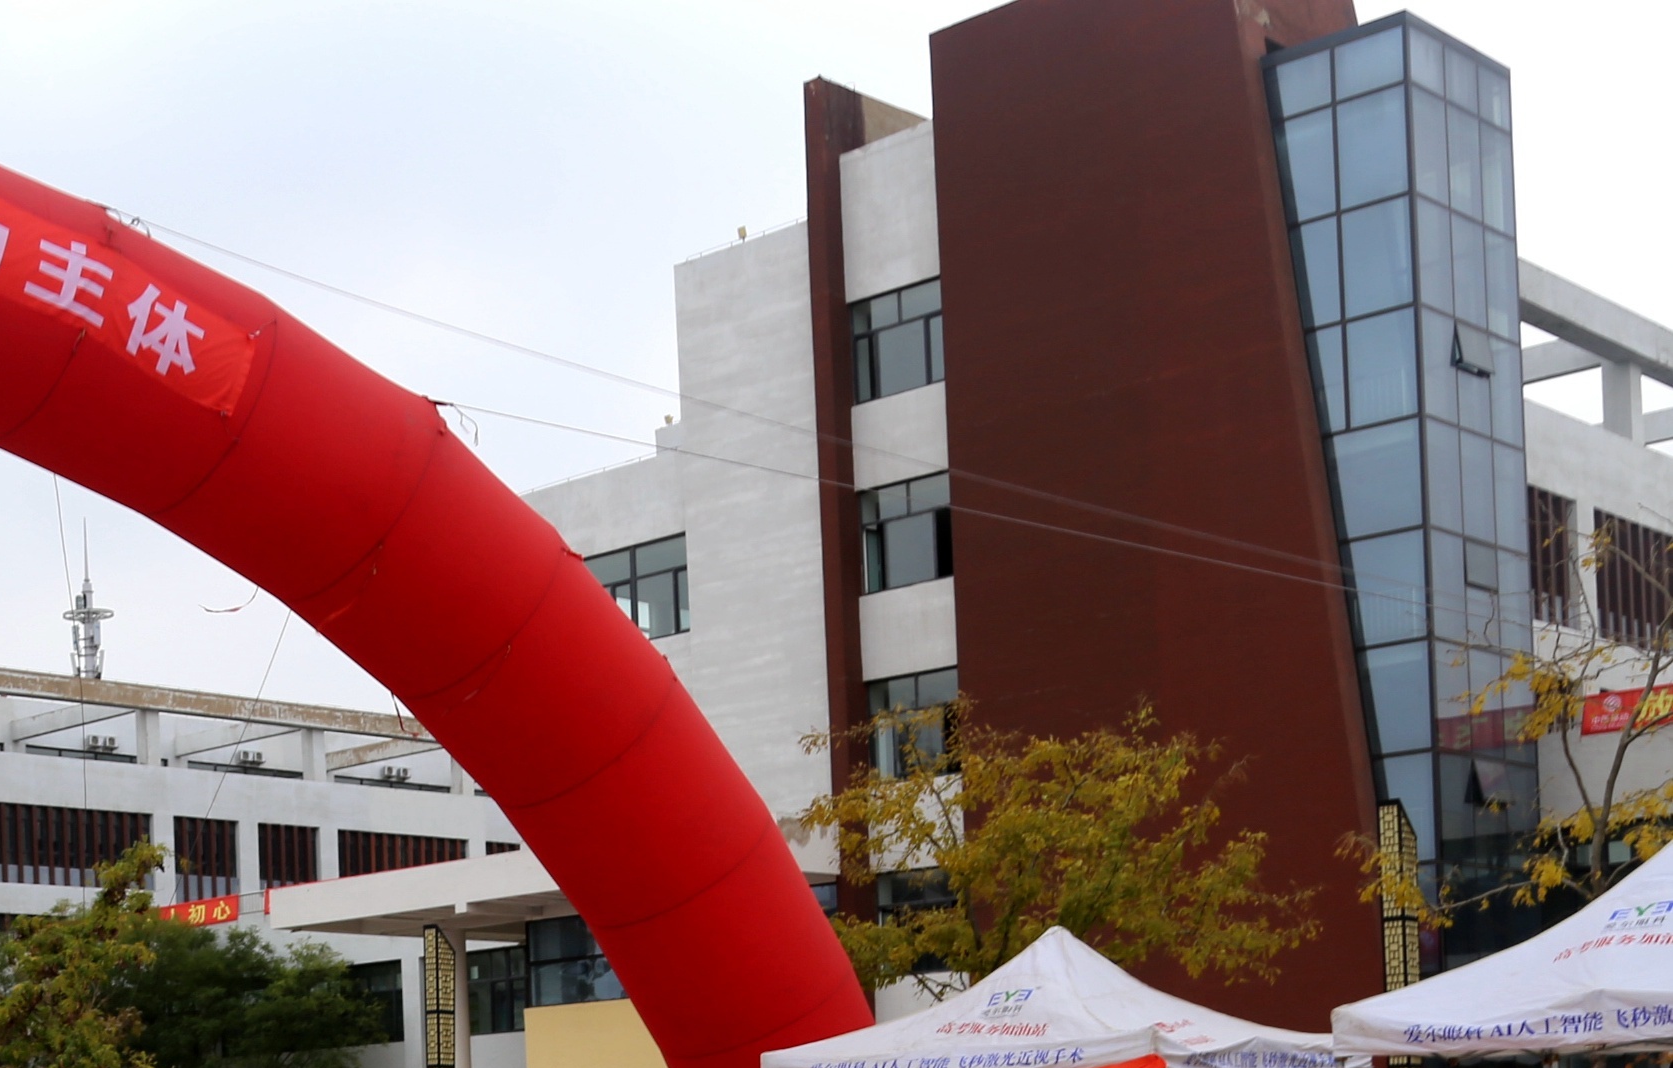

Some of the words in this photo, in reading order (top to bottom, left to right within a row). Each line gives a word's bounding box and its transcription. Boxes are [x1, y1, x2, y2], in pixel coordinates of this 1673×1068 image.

[1404, 1024, 1483, 1043] 爱尔眼科
[1489, 1011, 1604, 1037] AI人工智能
